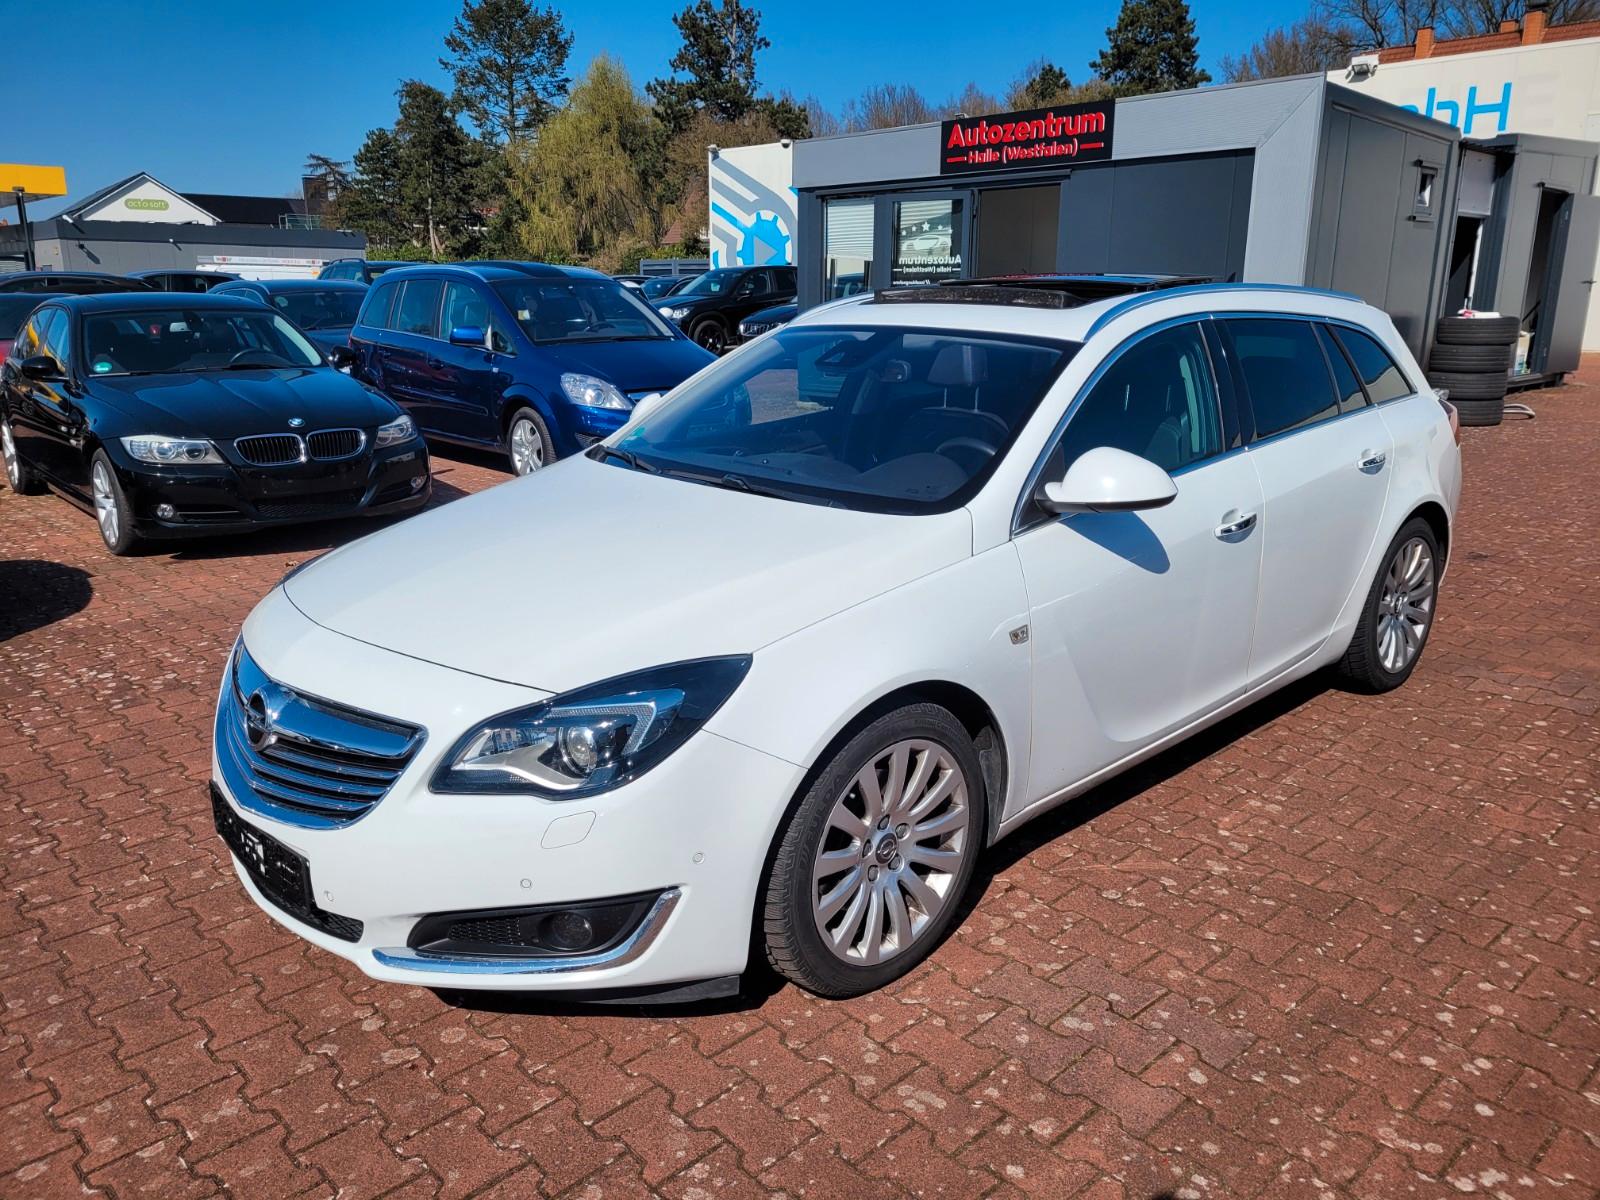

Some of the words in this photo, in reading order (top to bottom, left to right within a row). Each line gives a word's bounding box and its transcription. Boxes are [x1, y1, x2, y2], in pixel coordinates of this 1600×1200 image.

[1400, 82, 1513, 134] bH
[947, 112, 1105, 148] Autozentrum
[968, 149, 999, 164] Halle
[1002, 138, 1078, 164] (Westfalen)
